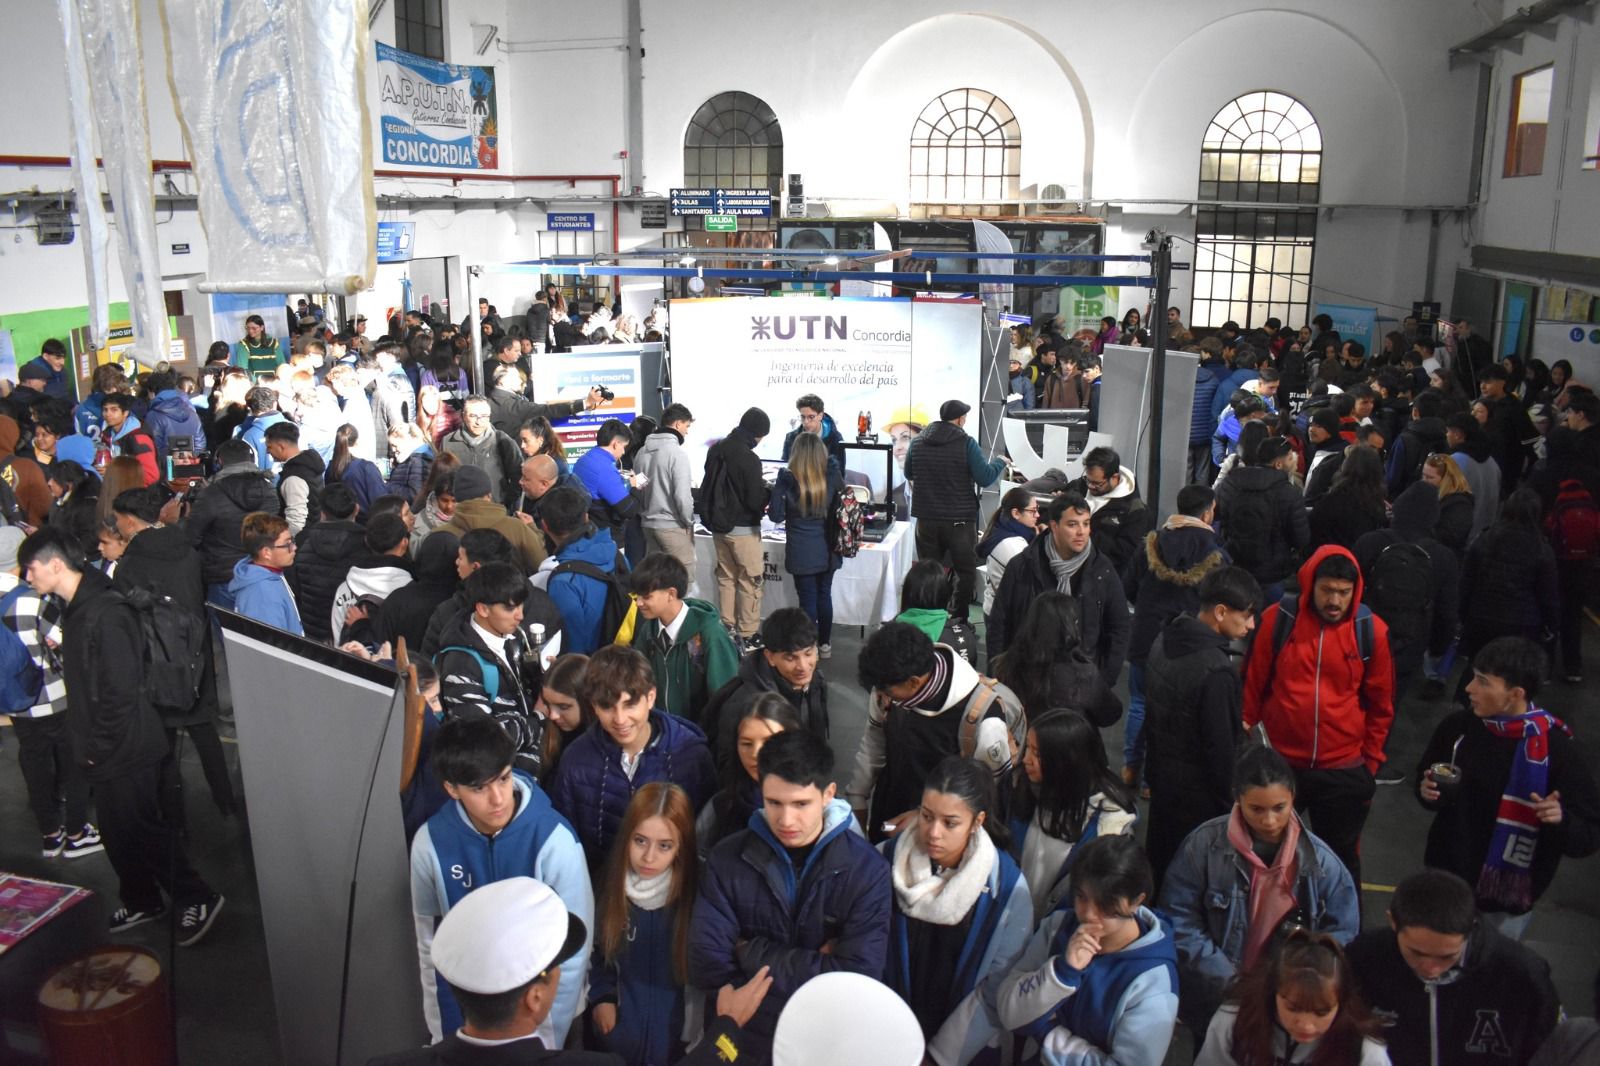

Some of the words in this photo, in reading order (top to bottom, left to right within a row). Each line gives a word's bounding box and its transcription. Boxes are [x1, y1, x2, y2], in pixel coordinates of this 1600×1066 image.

[382, 74, 470, 115] A.P.U.T.N.
[386, 138, 472, 165] CONCORDIA
[1073, 300, 1104, 317] ER
[773, 316, 848, 340] UTN
[853, 329, 912, 342] Concordia
[827, 360, 838, 371] de
[841, 360, 894, 372] excelencia
[591, 374, 631, 382] formarte
[767, 375, 793, 387] para
[795, 372, 804, 384] el
[806, 372, 857, 384] desarrollo
[859, 373, 875, 385] del
[877, 374, 898, 388] país
[1465, 1008, 1511, 1057] A
